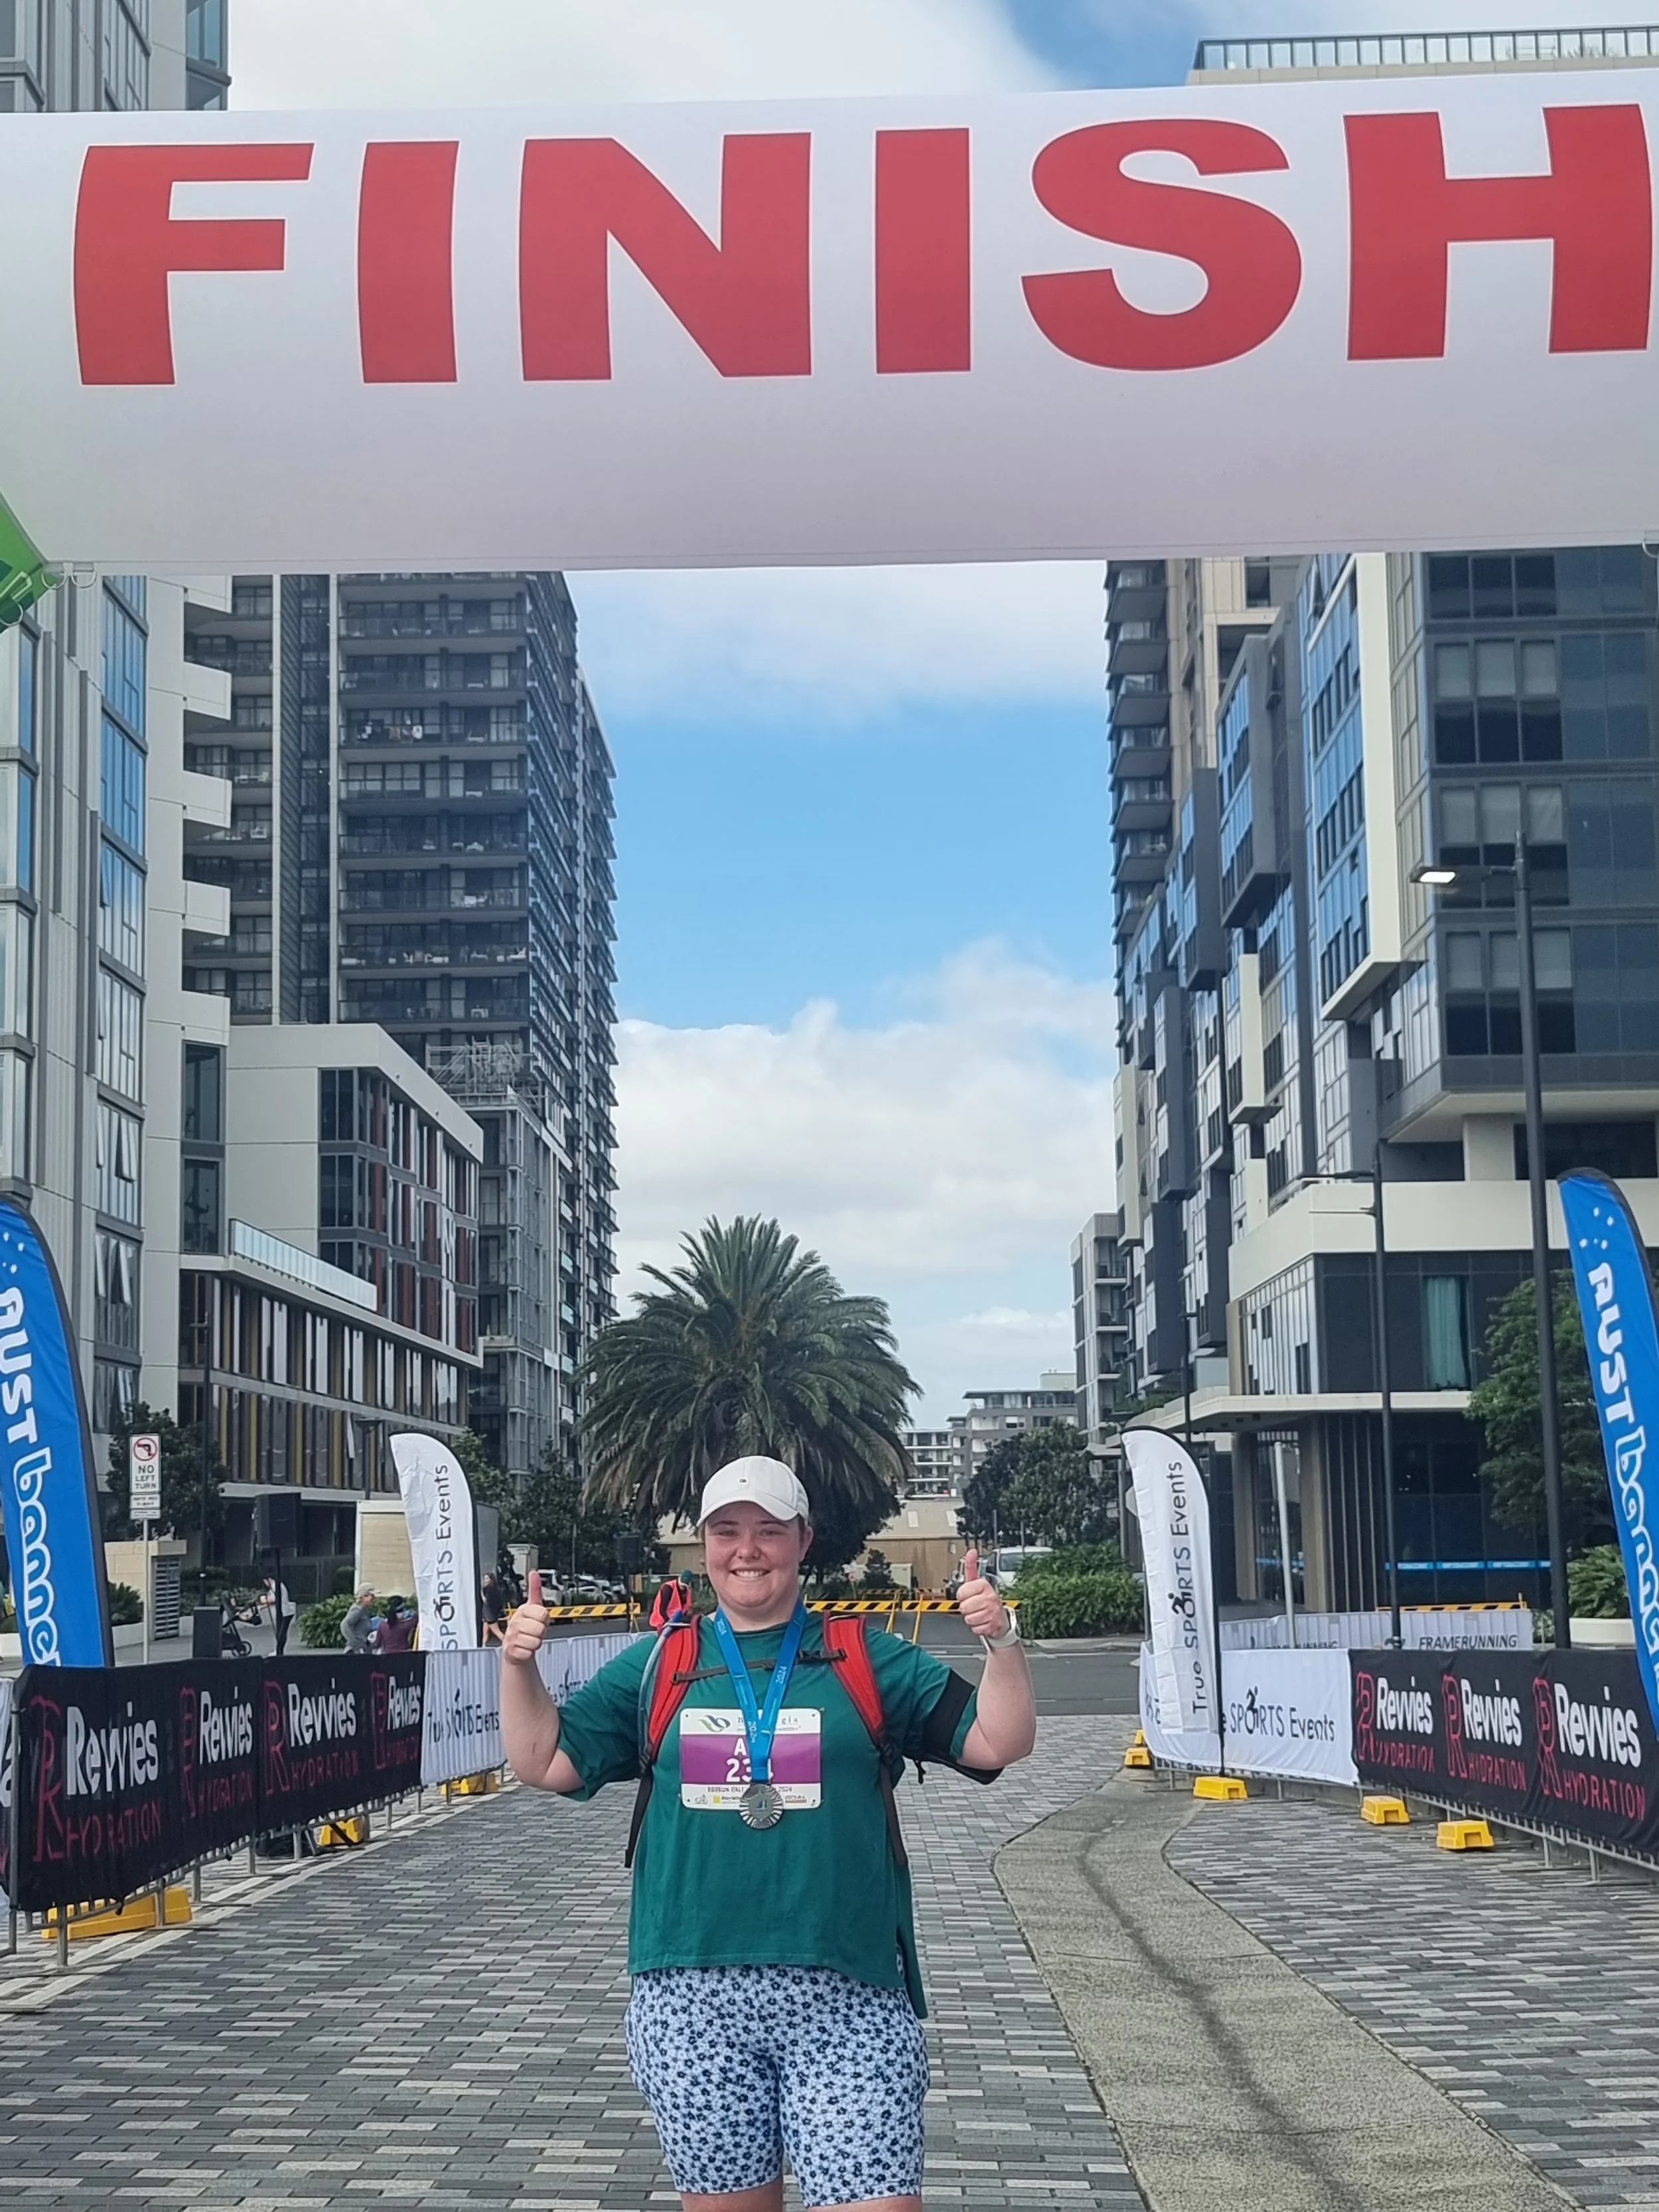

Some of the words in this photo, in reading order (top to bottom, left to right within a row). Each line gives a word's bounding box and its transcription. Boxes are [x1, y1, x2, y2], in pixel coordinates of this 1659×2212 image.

[74, 103, 1652, 385] FINISH
[0, 1286, 38, 1445] AUST
[1588, 1262, 1634, 1424] AUST
[138, 1465, 155, 1473] NO
[434, 1464, 452, 1540] Events
[1167, 1461, 1190, 1537] Events
[1173, 1546, 1198, 1649] SPORTS
[1419, 1634, 1519, 1649] FRAMERUNNING
[287, 1678, 356, 1747] Revvies
[1192, 1661, 1208, 1714] True
[1230, 1699, 1285, 1738] SPORTS
[1289, 1707, 1335, 1743] Events
[1376, 1675, 1433, 1735] Revvies
[1461, 1678, 1523, 1747] Revvies
[67, 1702, 159, 1795] Revvies
[199, 1686, 253, 1765] Revvies
[1553, 1682, 1642, 1768] Revvies
[1467, 1752, 1527, 1791] HYDRATION
[1561, 1768, 1646, 1822] HYDRATION
